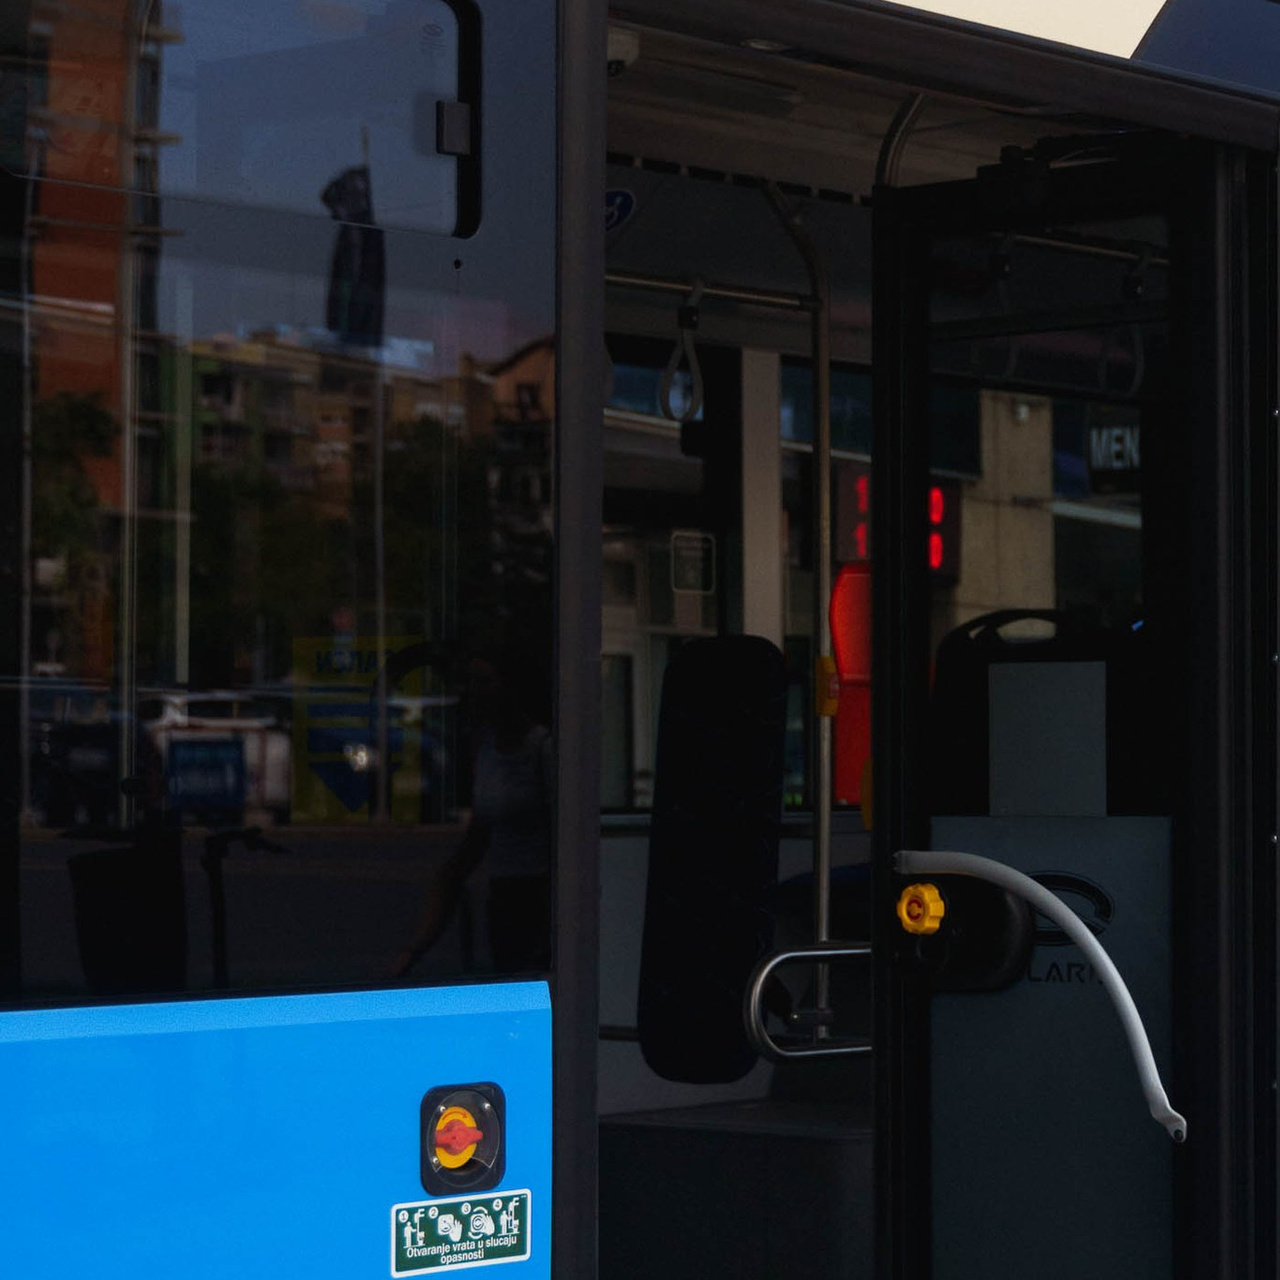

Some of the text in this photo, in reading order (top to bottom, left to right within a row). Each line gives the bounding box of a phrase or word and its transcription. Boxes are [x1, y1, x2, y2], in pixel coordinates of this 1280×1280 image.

[1090, 425, 1141, 471] MEN
[407, 1243, 450, 1258] Otvaranje
[452, 1239, 476, 1252] vrata
[477, 1239, 484, 1248] u
[440, 1250, 484, 1265] opasnosti
